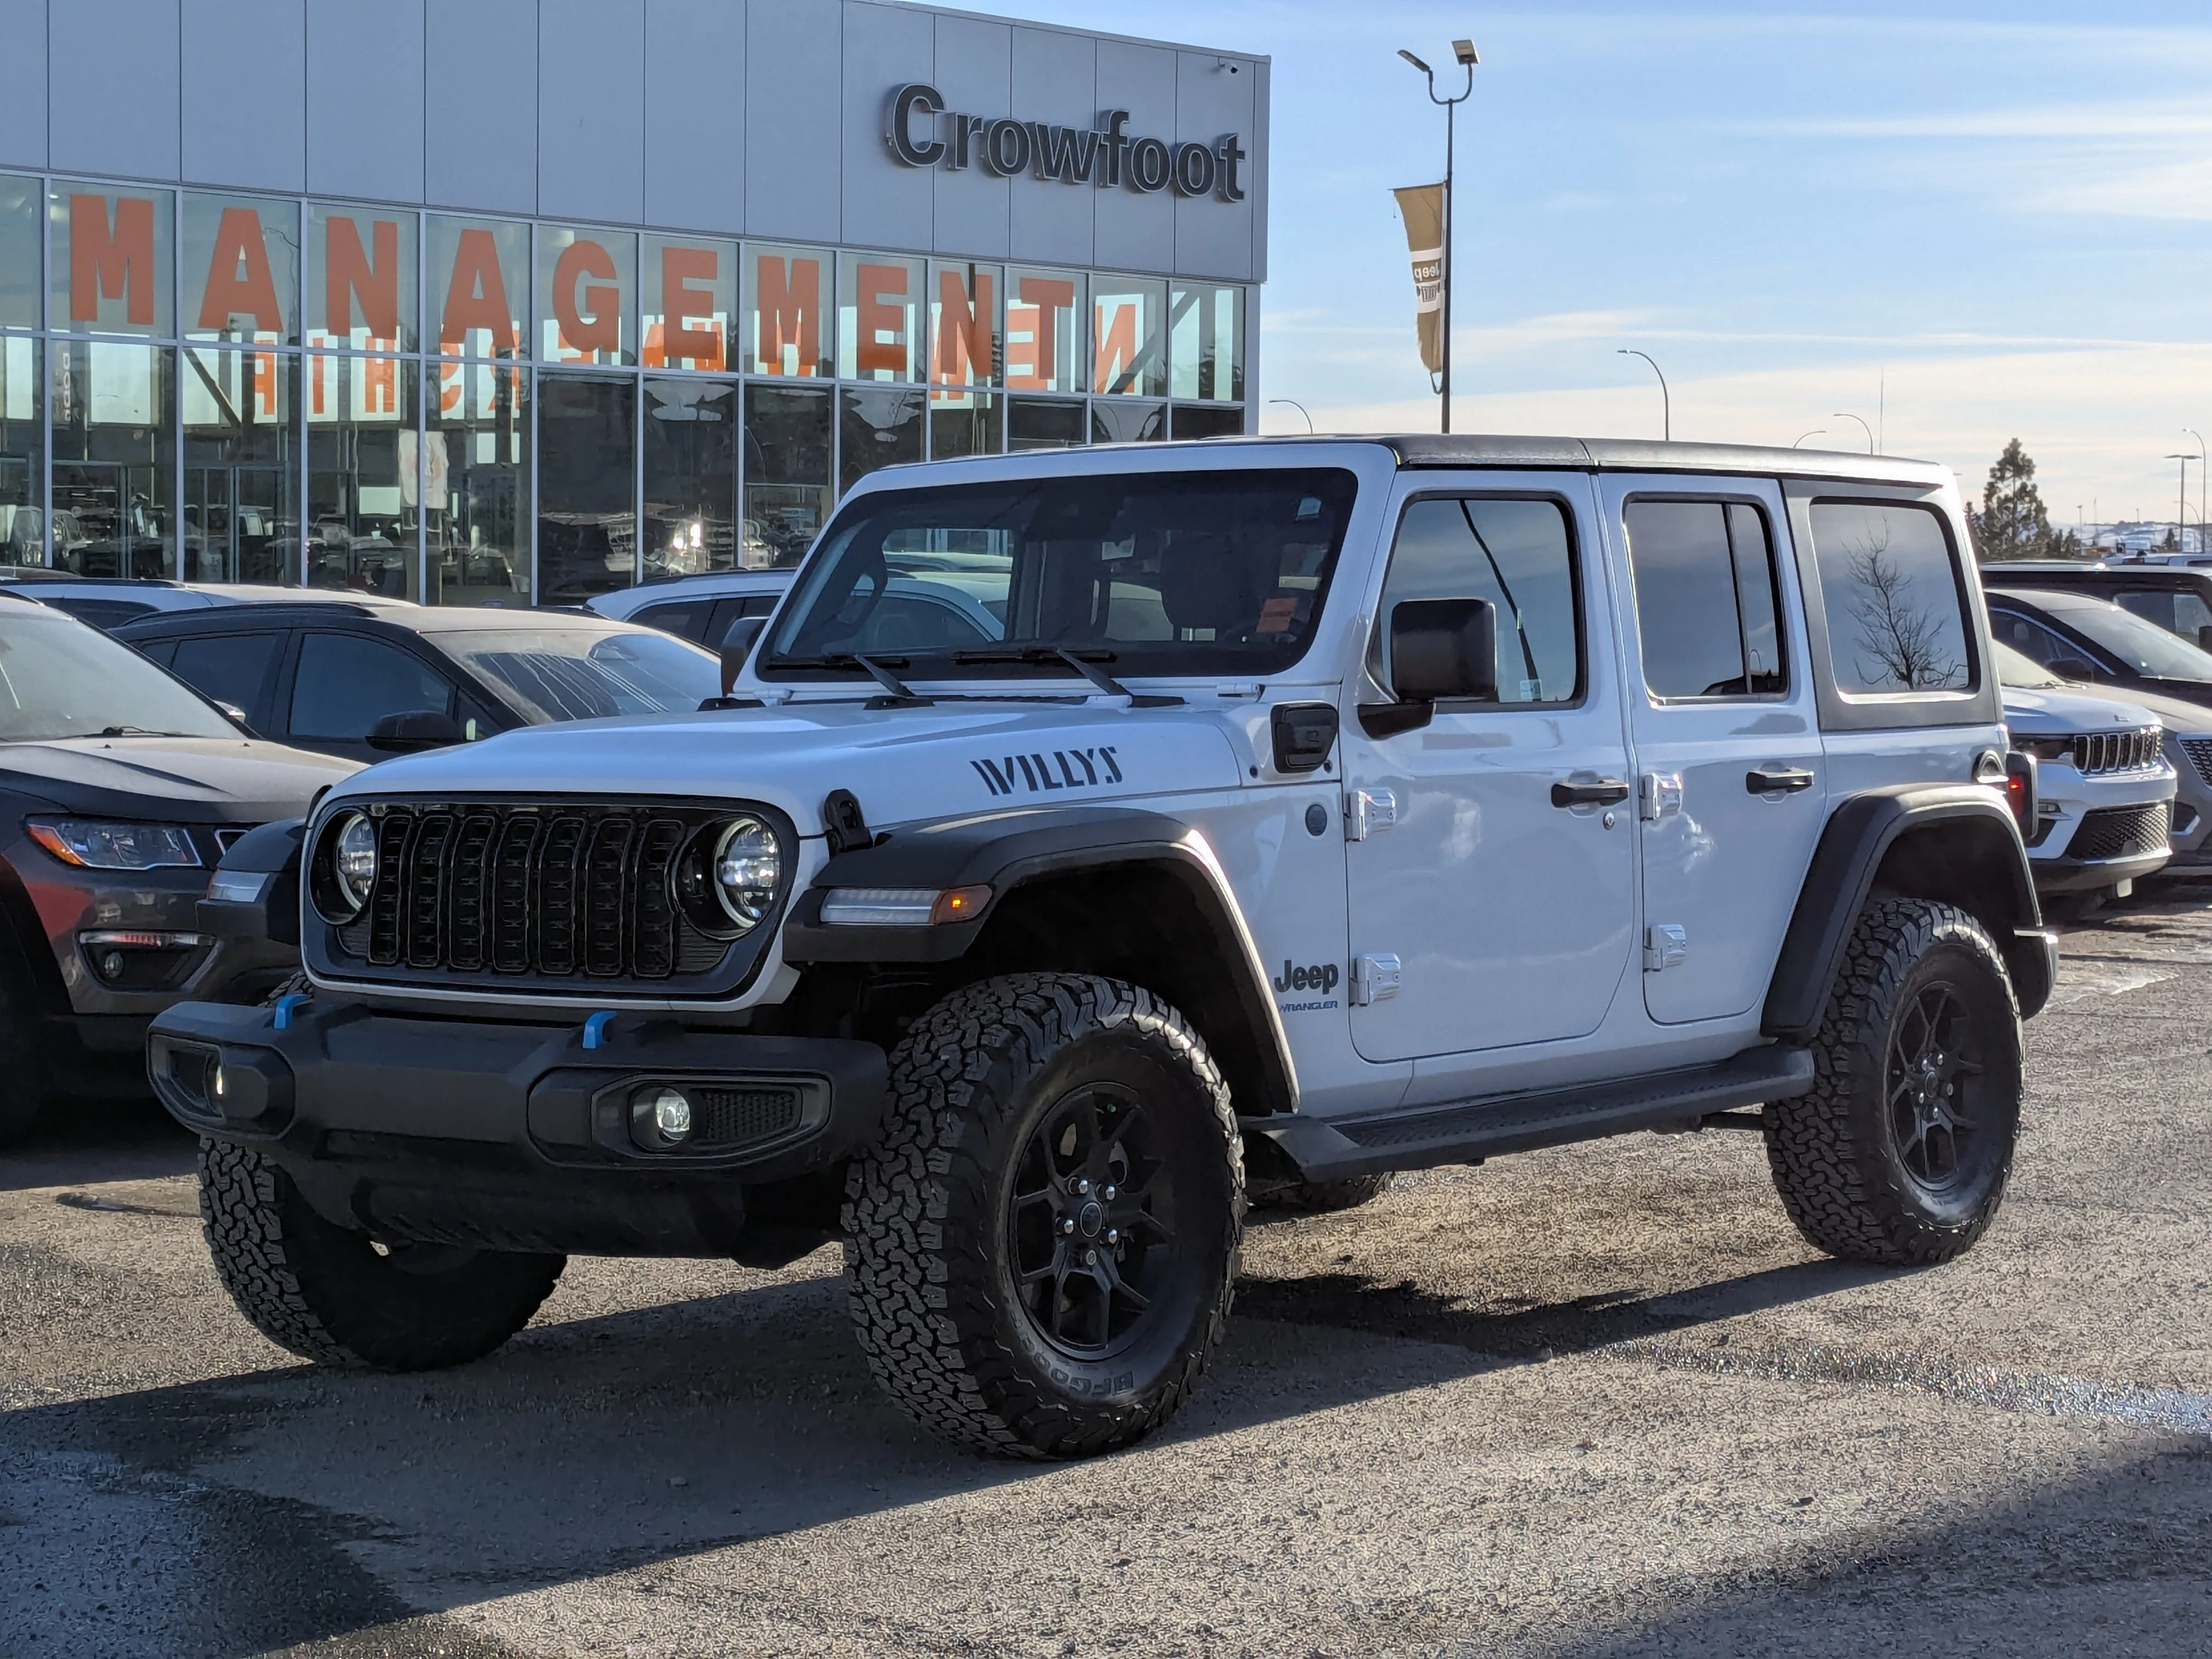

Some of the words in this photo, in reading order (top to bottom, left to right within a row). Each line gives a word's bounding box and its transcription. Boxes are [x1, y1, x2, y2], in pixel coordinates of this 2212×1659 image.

[890, 82, 1246, 202] Crowfoot
[70, 194, 1074, 380] MANAGEMENT
[969, 746, 1122, 795] WILLYS
[1274, 960, 1339, 995] Jeep
[1280, 1001, 1338, 1012] WRANGLER
